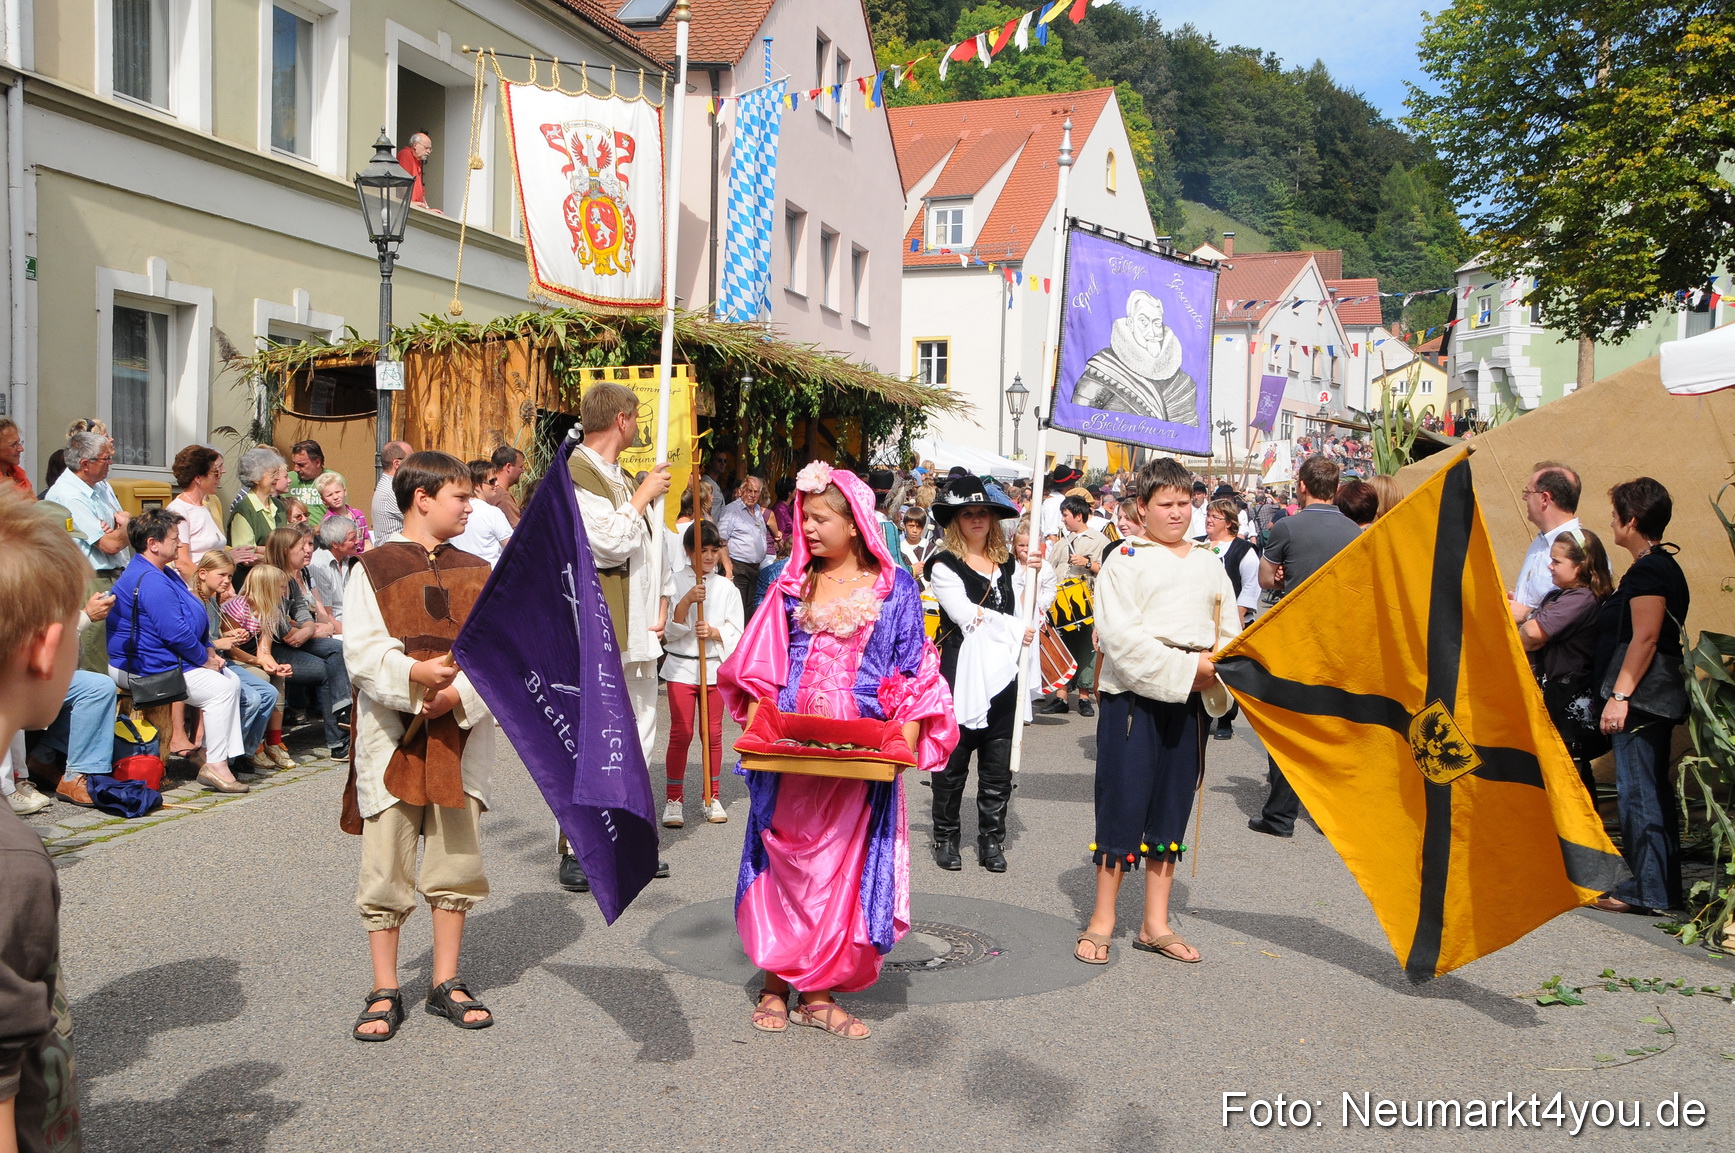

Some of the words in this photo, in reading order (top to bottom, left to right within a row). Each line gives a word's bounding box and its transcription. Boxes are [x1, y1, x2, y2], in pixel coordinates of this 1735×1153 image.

[1072, 272, 1099, 314] Graf
[1082, 412, 1179, 438] Breitenbrunn
[290, 487, 321, 496] CUSTO
